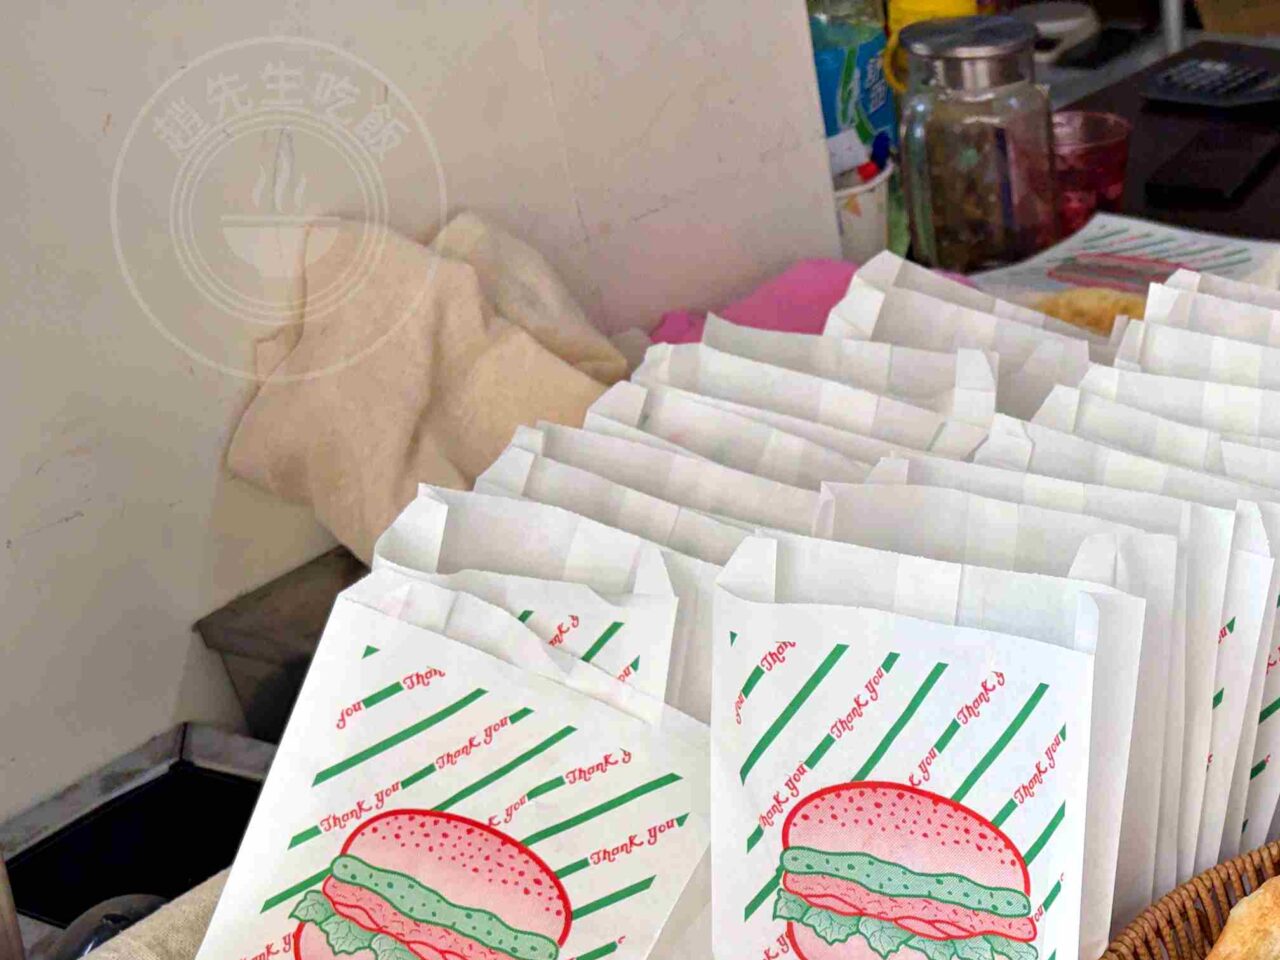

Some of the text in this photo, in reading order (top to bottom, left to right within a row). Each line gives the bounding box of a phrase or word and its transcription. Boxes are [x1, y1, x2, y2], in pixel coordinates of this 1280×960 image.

[402, 666, 446, 690] Than
[617, 665, 632, 682] ou
[760, 641, 796, 671] Than
[759, 665, 885, 827] hank you Thank you
[918, 680, 996, 781] you Thank
[319, 716, 509, 832] Thank you Thank you
[503, 795, 527, 824] you
[565, 753, 619, 785] Thank
[1013, 733, 1061, 804] Thank you
[590, 817, 677, 866] Thank you
[1034, 904, 1044, 922] ou
